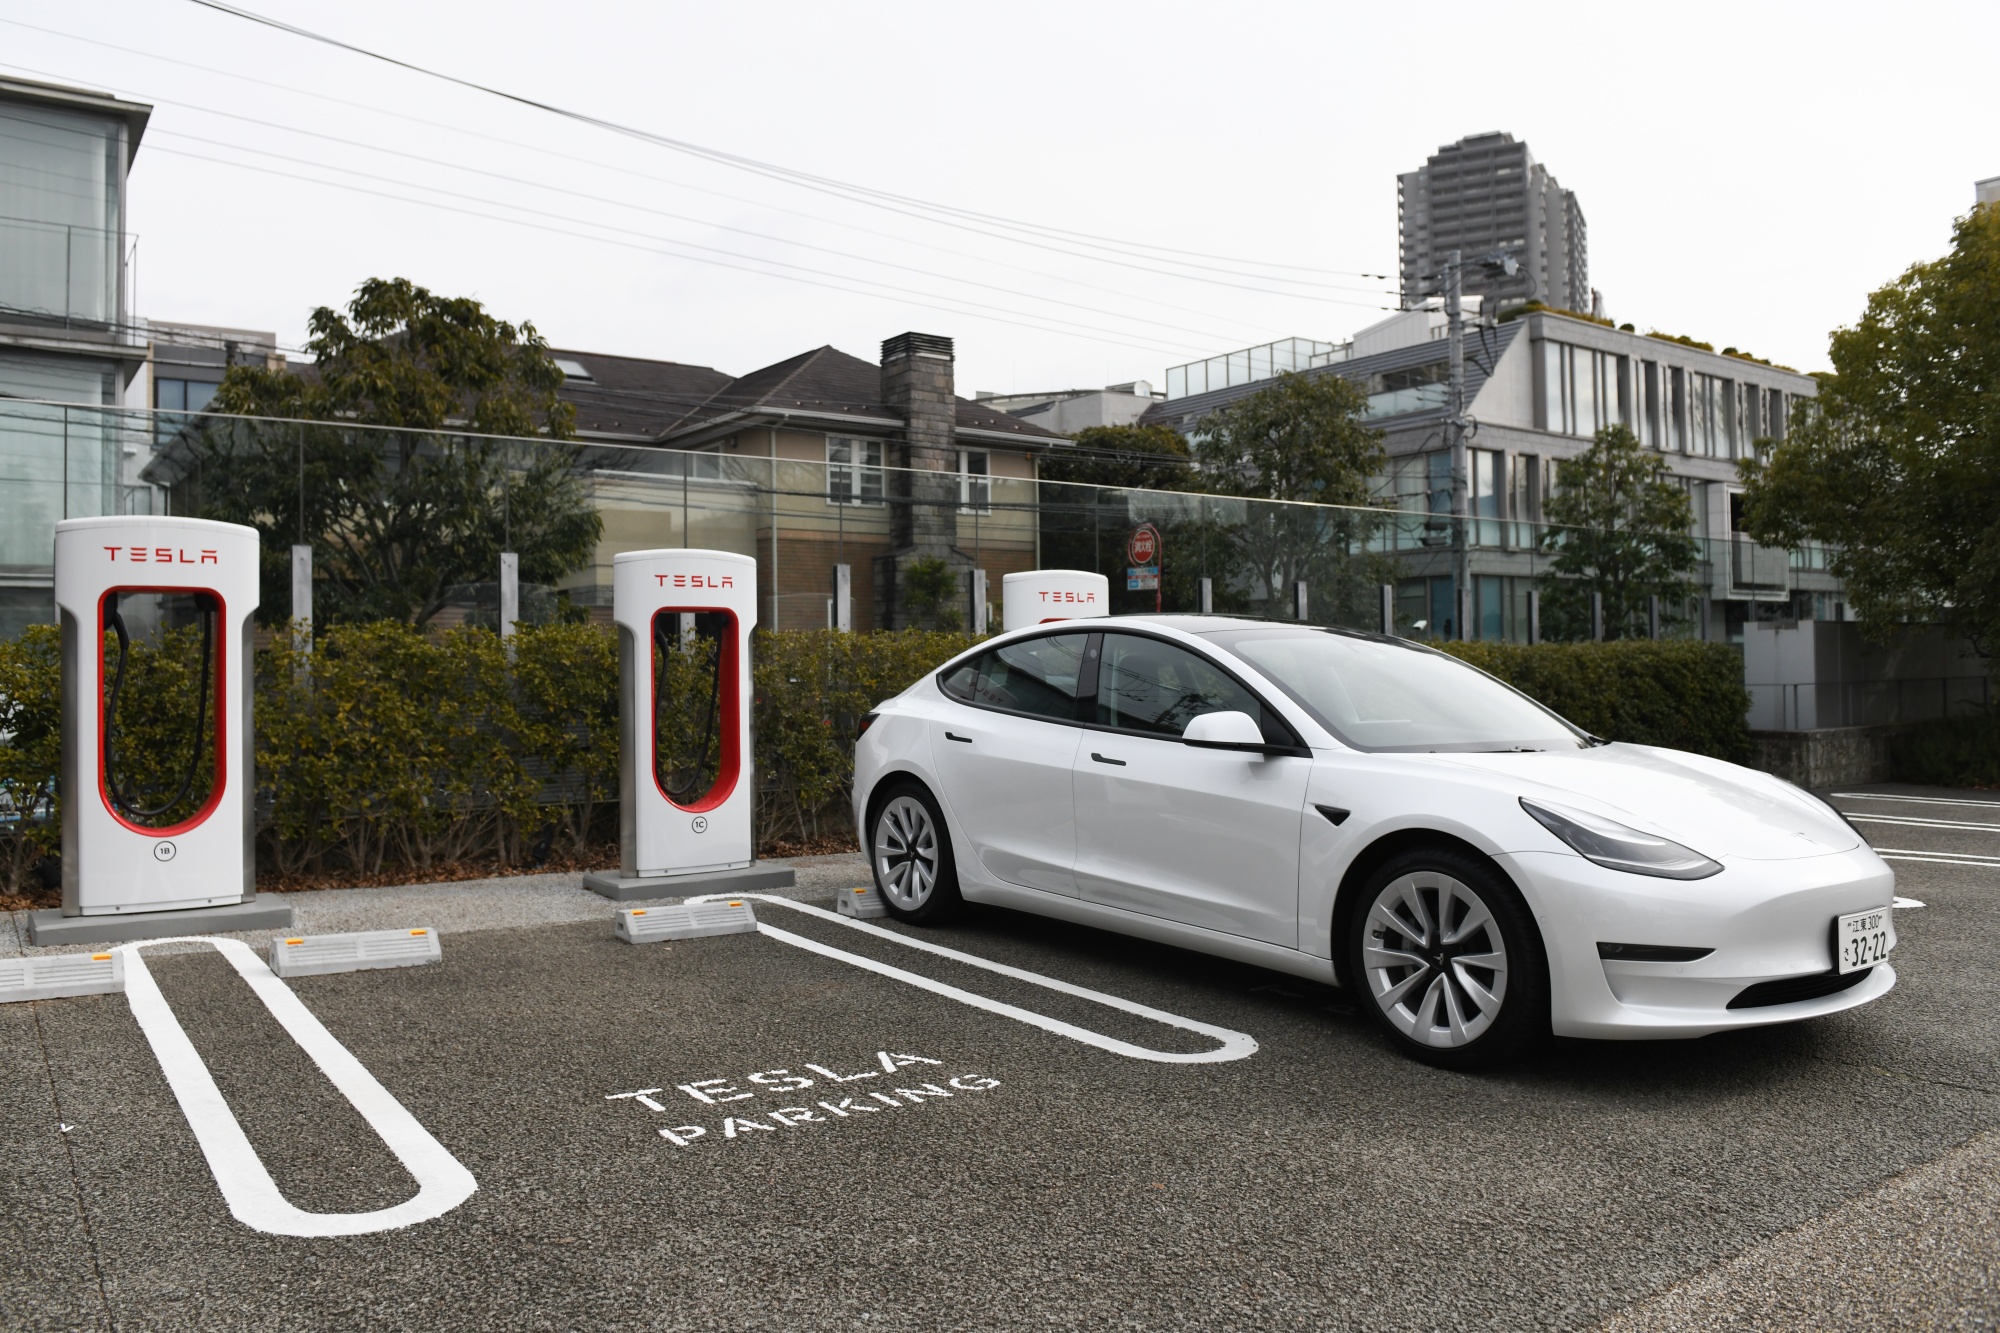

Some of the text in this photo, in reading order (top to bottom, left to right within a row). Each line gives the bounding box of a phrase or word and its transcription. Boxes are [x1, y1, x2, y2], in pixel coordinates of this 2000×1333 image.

[103, 546, 218, 564] TESLA
[654, 574, 733, 588] TESLA
[1038, 591, 1095, 603] TESLA
[604, 1051, 943, 1113] TESLA
[658, 1073, 1001, 1146] PARKING
